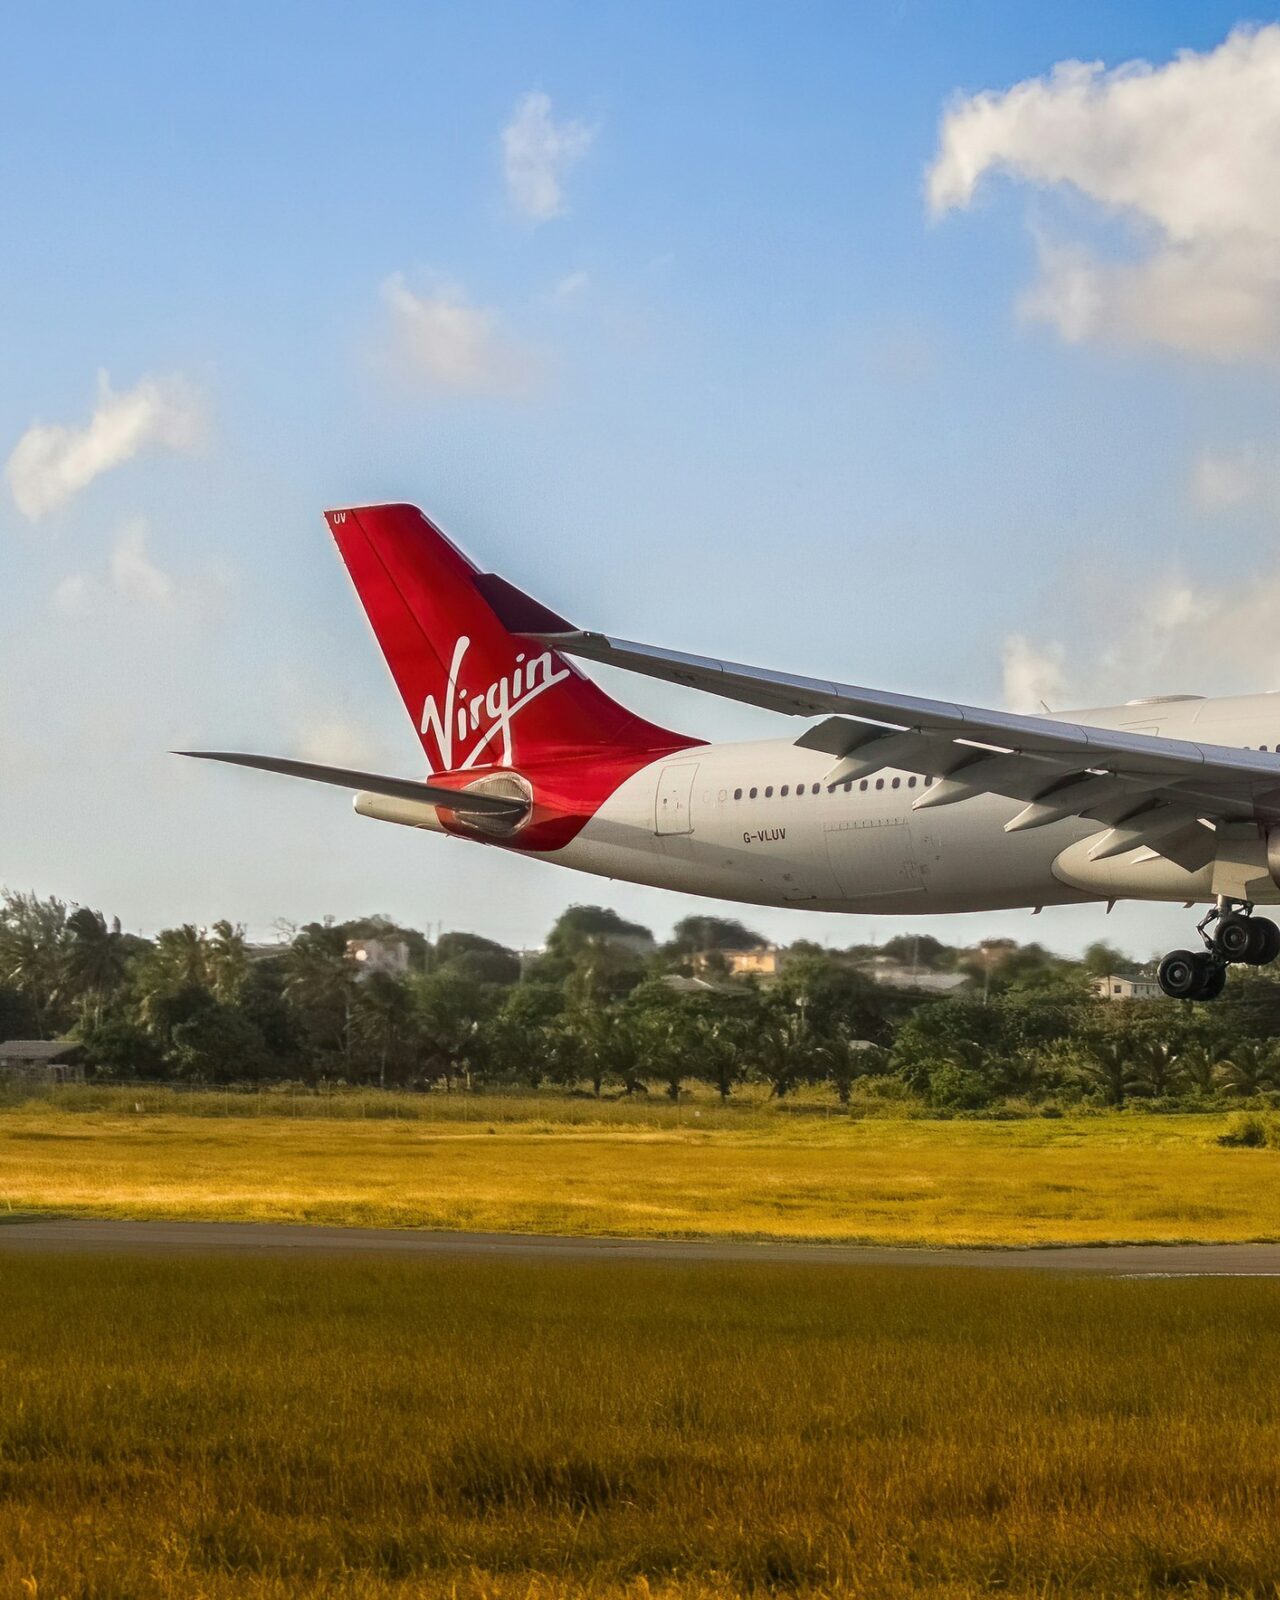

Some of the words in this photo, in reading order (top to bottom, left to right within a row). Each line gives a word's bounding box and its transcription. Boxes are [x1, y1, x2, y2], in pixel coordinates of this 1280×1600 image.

[333, 512, 346, 524] UV
[421, 636, 570, 770] Virgin
[743, 828, 786, 843] G-VLUV
